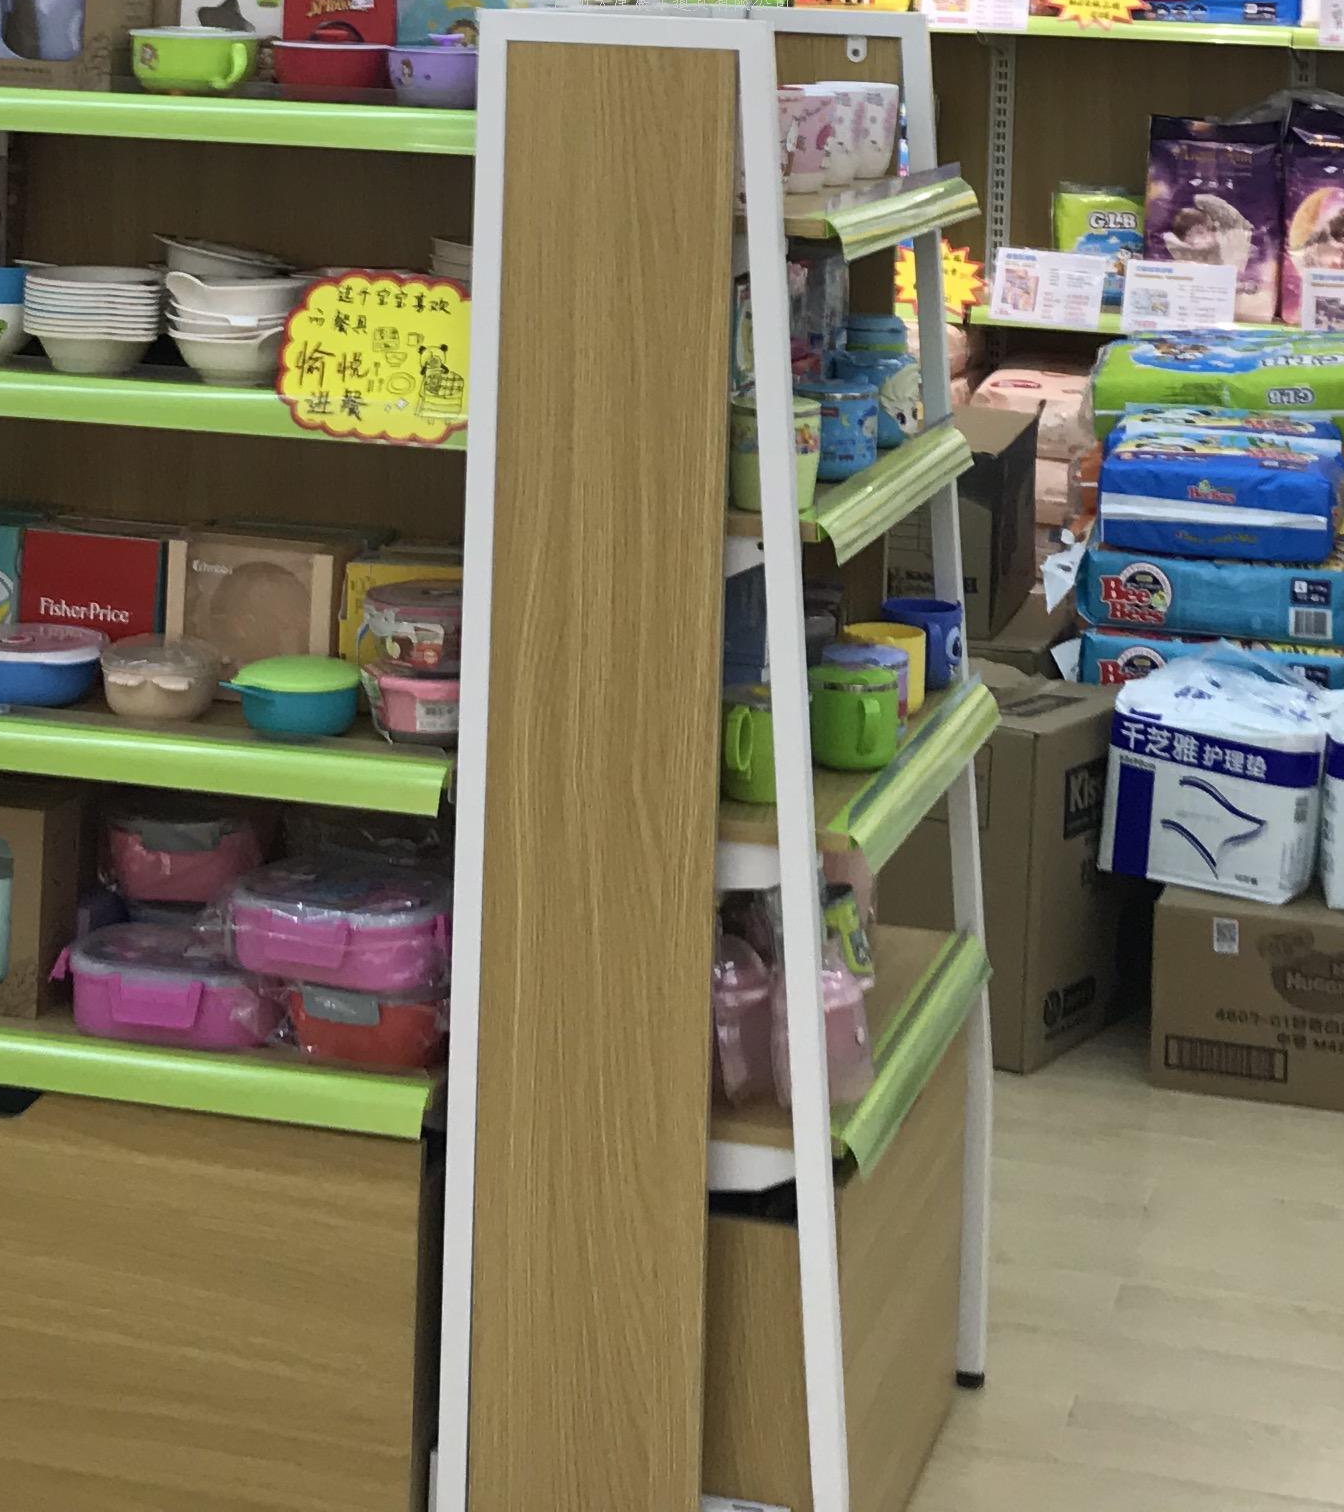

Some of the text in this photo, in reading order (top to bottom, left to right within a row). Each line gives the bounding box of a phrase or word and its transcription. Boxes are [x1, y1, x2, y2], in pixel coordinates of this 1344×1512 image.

[295, 339, 370, 388] 愉悦
[1202, 743, 1267, 780] 护理垫
